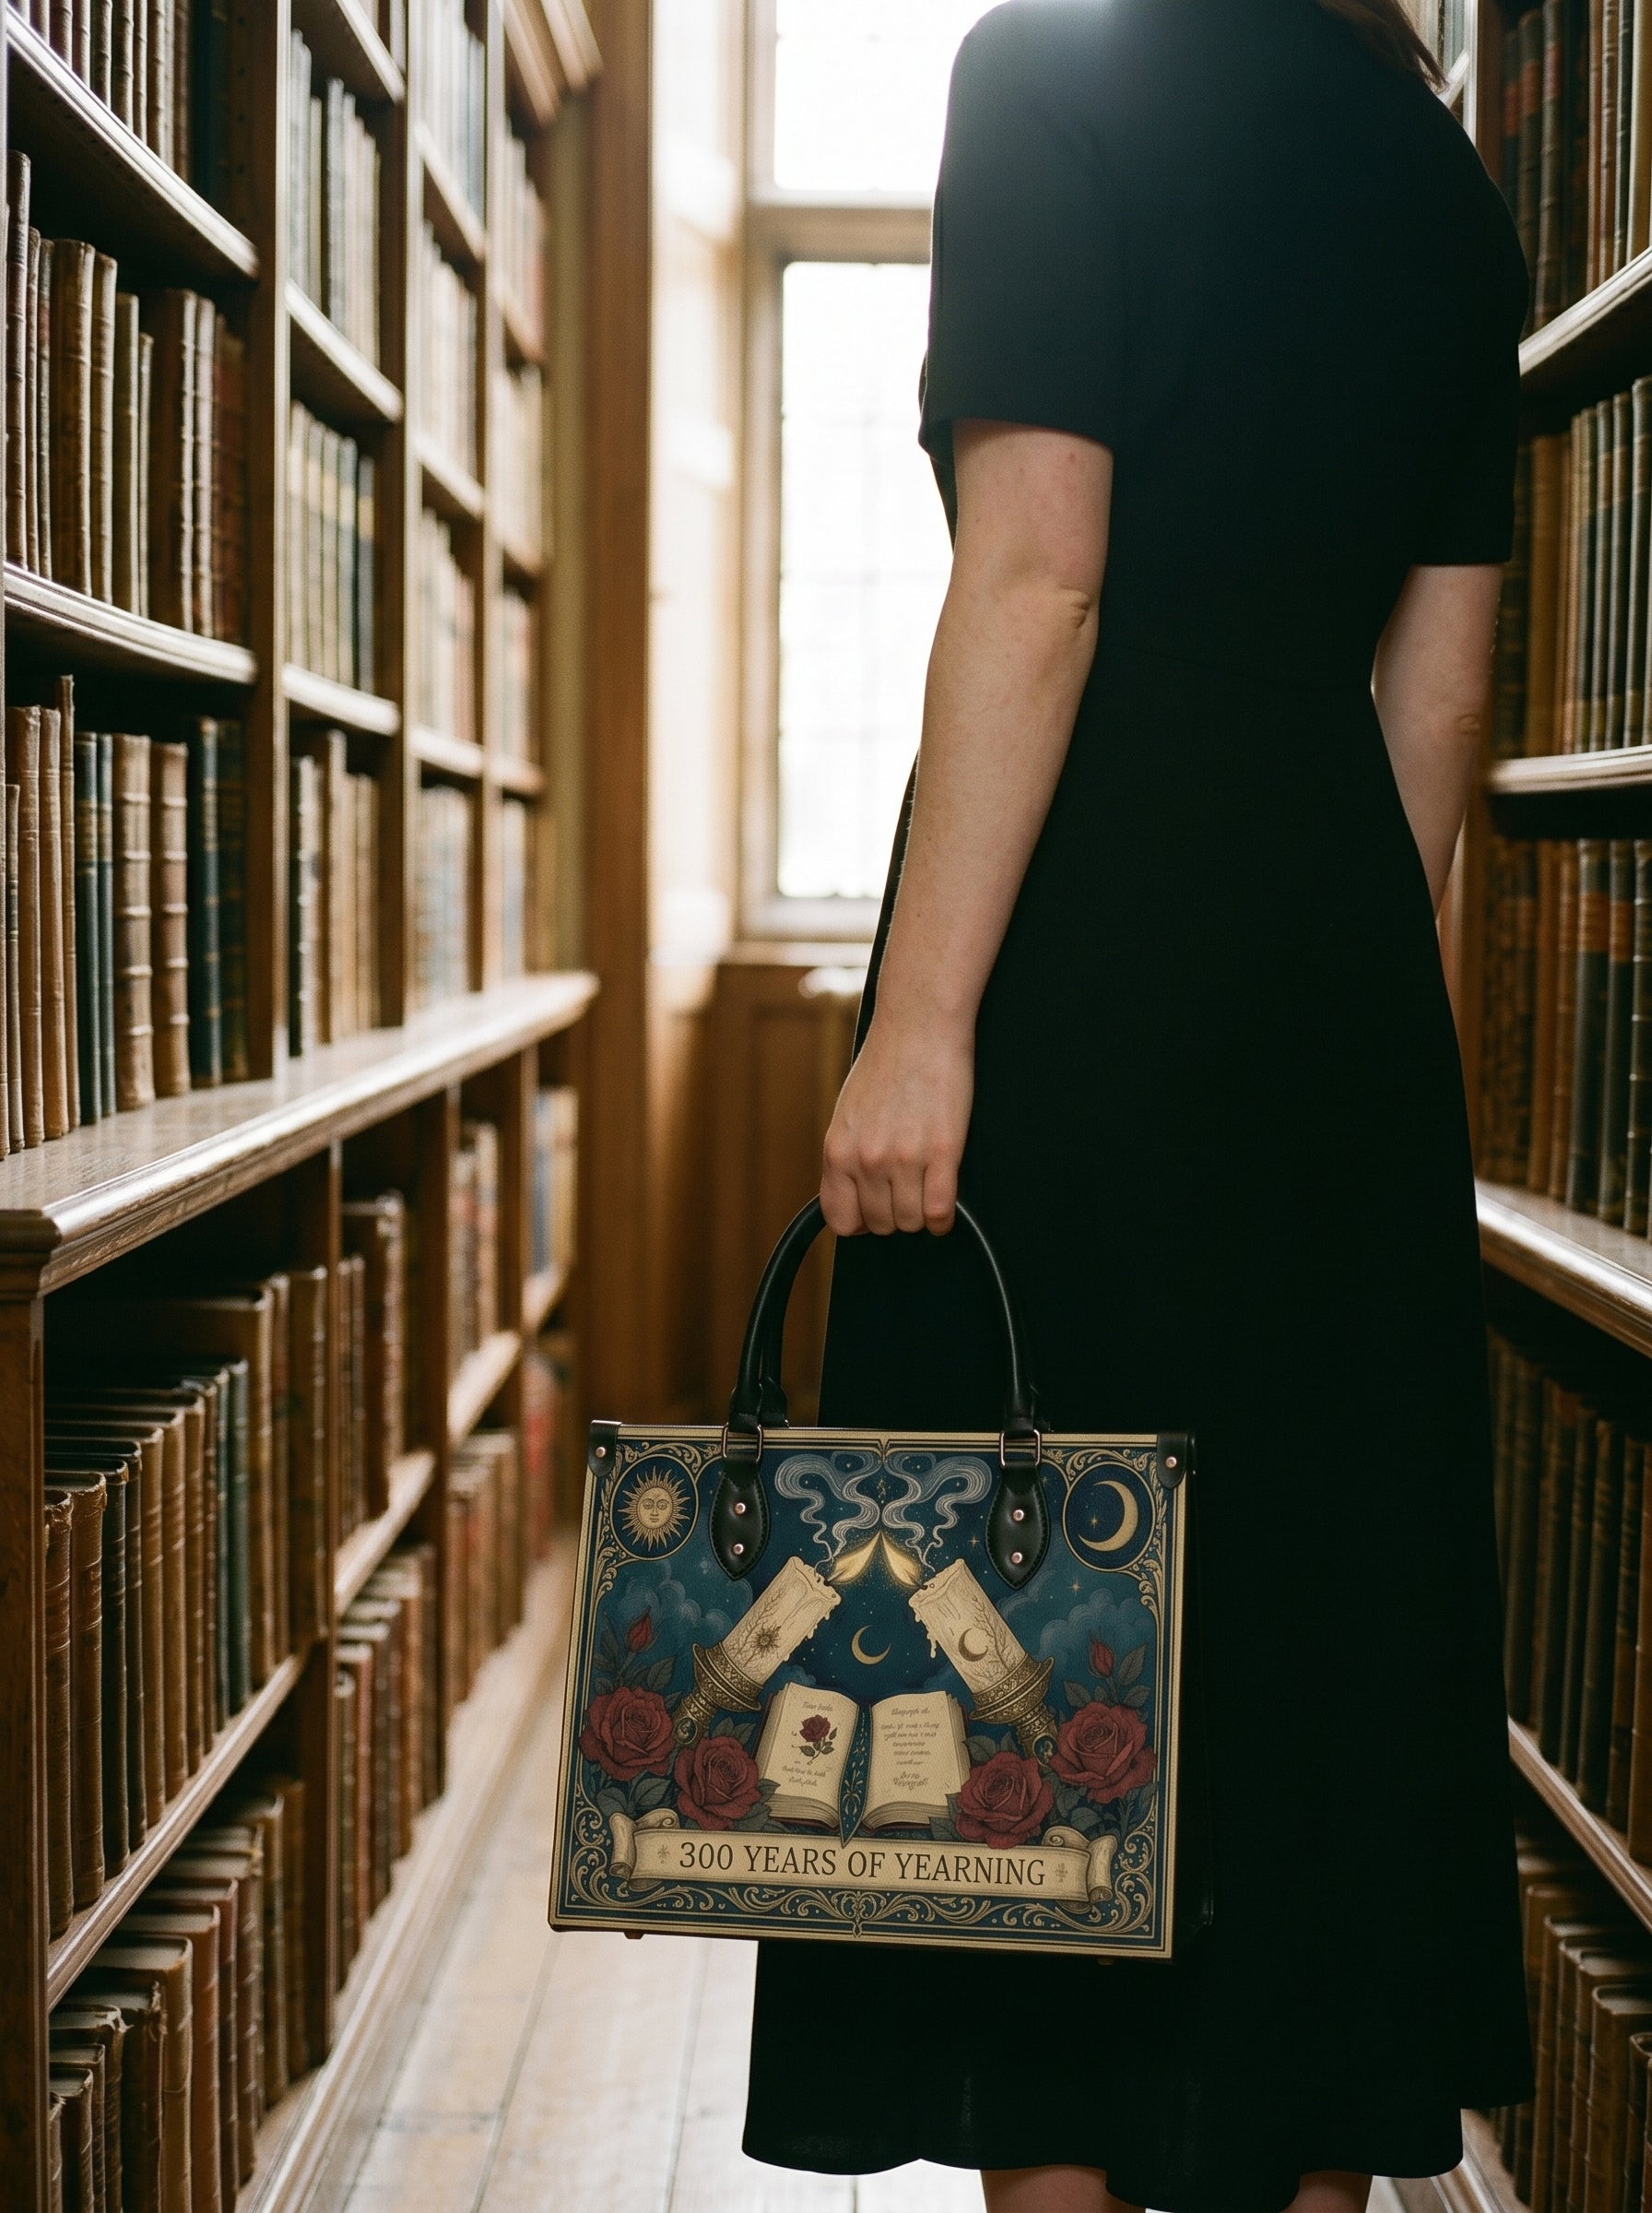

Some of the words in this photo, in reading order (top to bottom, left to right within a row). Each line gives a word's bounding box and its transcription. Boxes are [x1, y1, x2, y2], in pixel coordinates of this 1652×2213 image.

[679, 1841, 734, 1870] 300
[743, 1844, 836, 1876] YEARS
[847, 1851, 886, 1878] OF
[894, 1852, 1045, 1886] YEARNING
